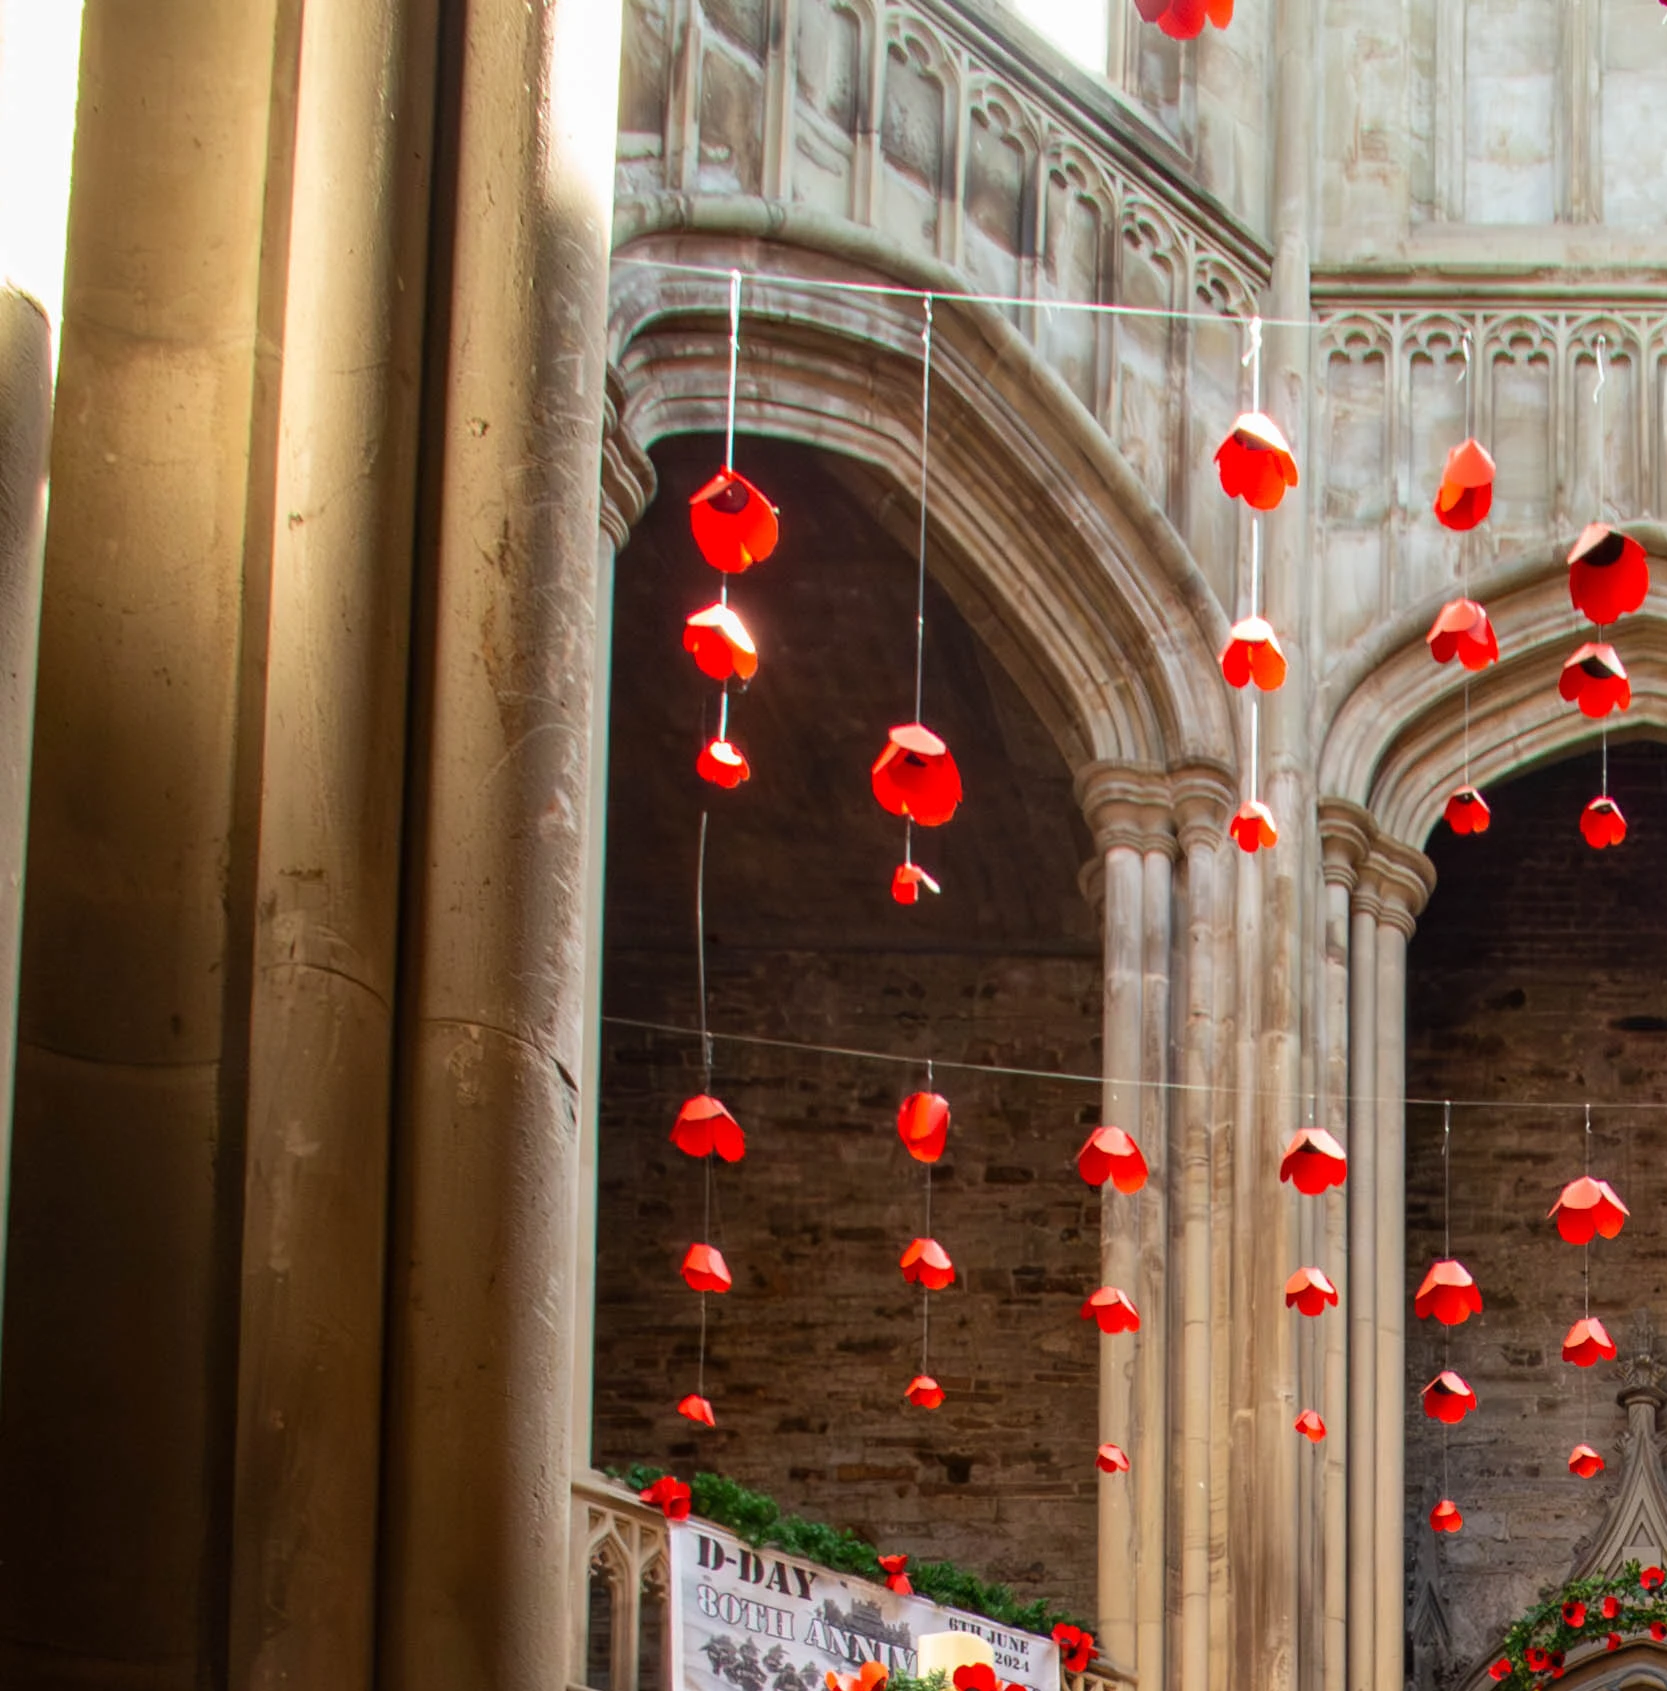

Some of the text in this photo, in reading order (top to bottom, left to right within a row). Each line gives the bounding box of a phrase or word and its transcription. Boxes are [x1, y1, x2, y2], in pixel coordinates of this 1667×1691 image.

[696, 1533, 819, 1602] D-DAY
[696, 1583, 918, 1681] 80TH ANNIV
[949, 1616, 1029, 1655] 6TH JUNE
[994, 1651, 1029, 1673] 2024
